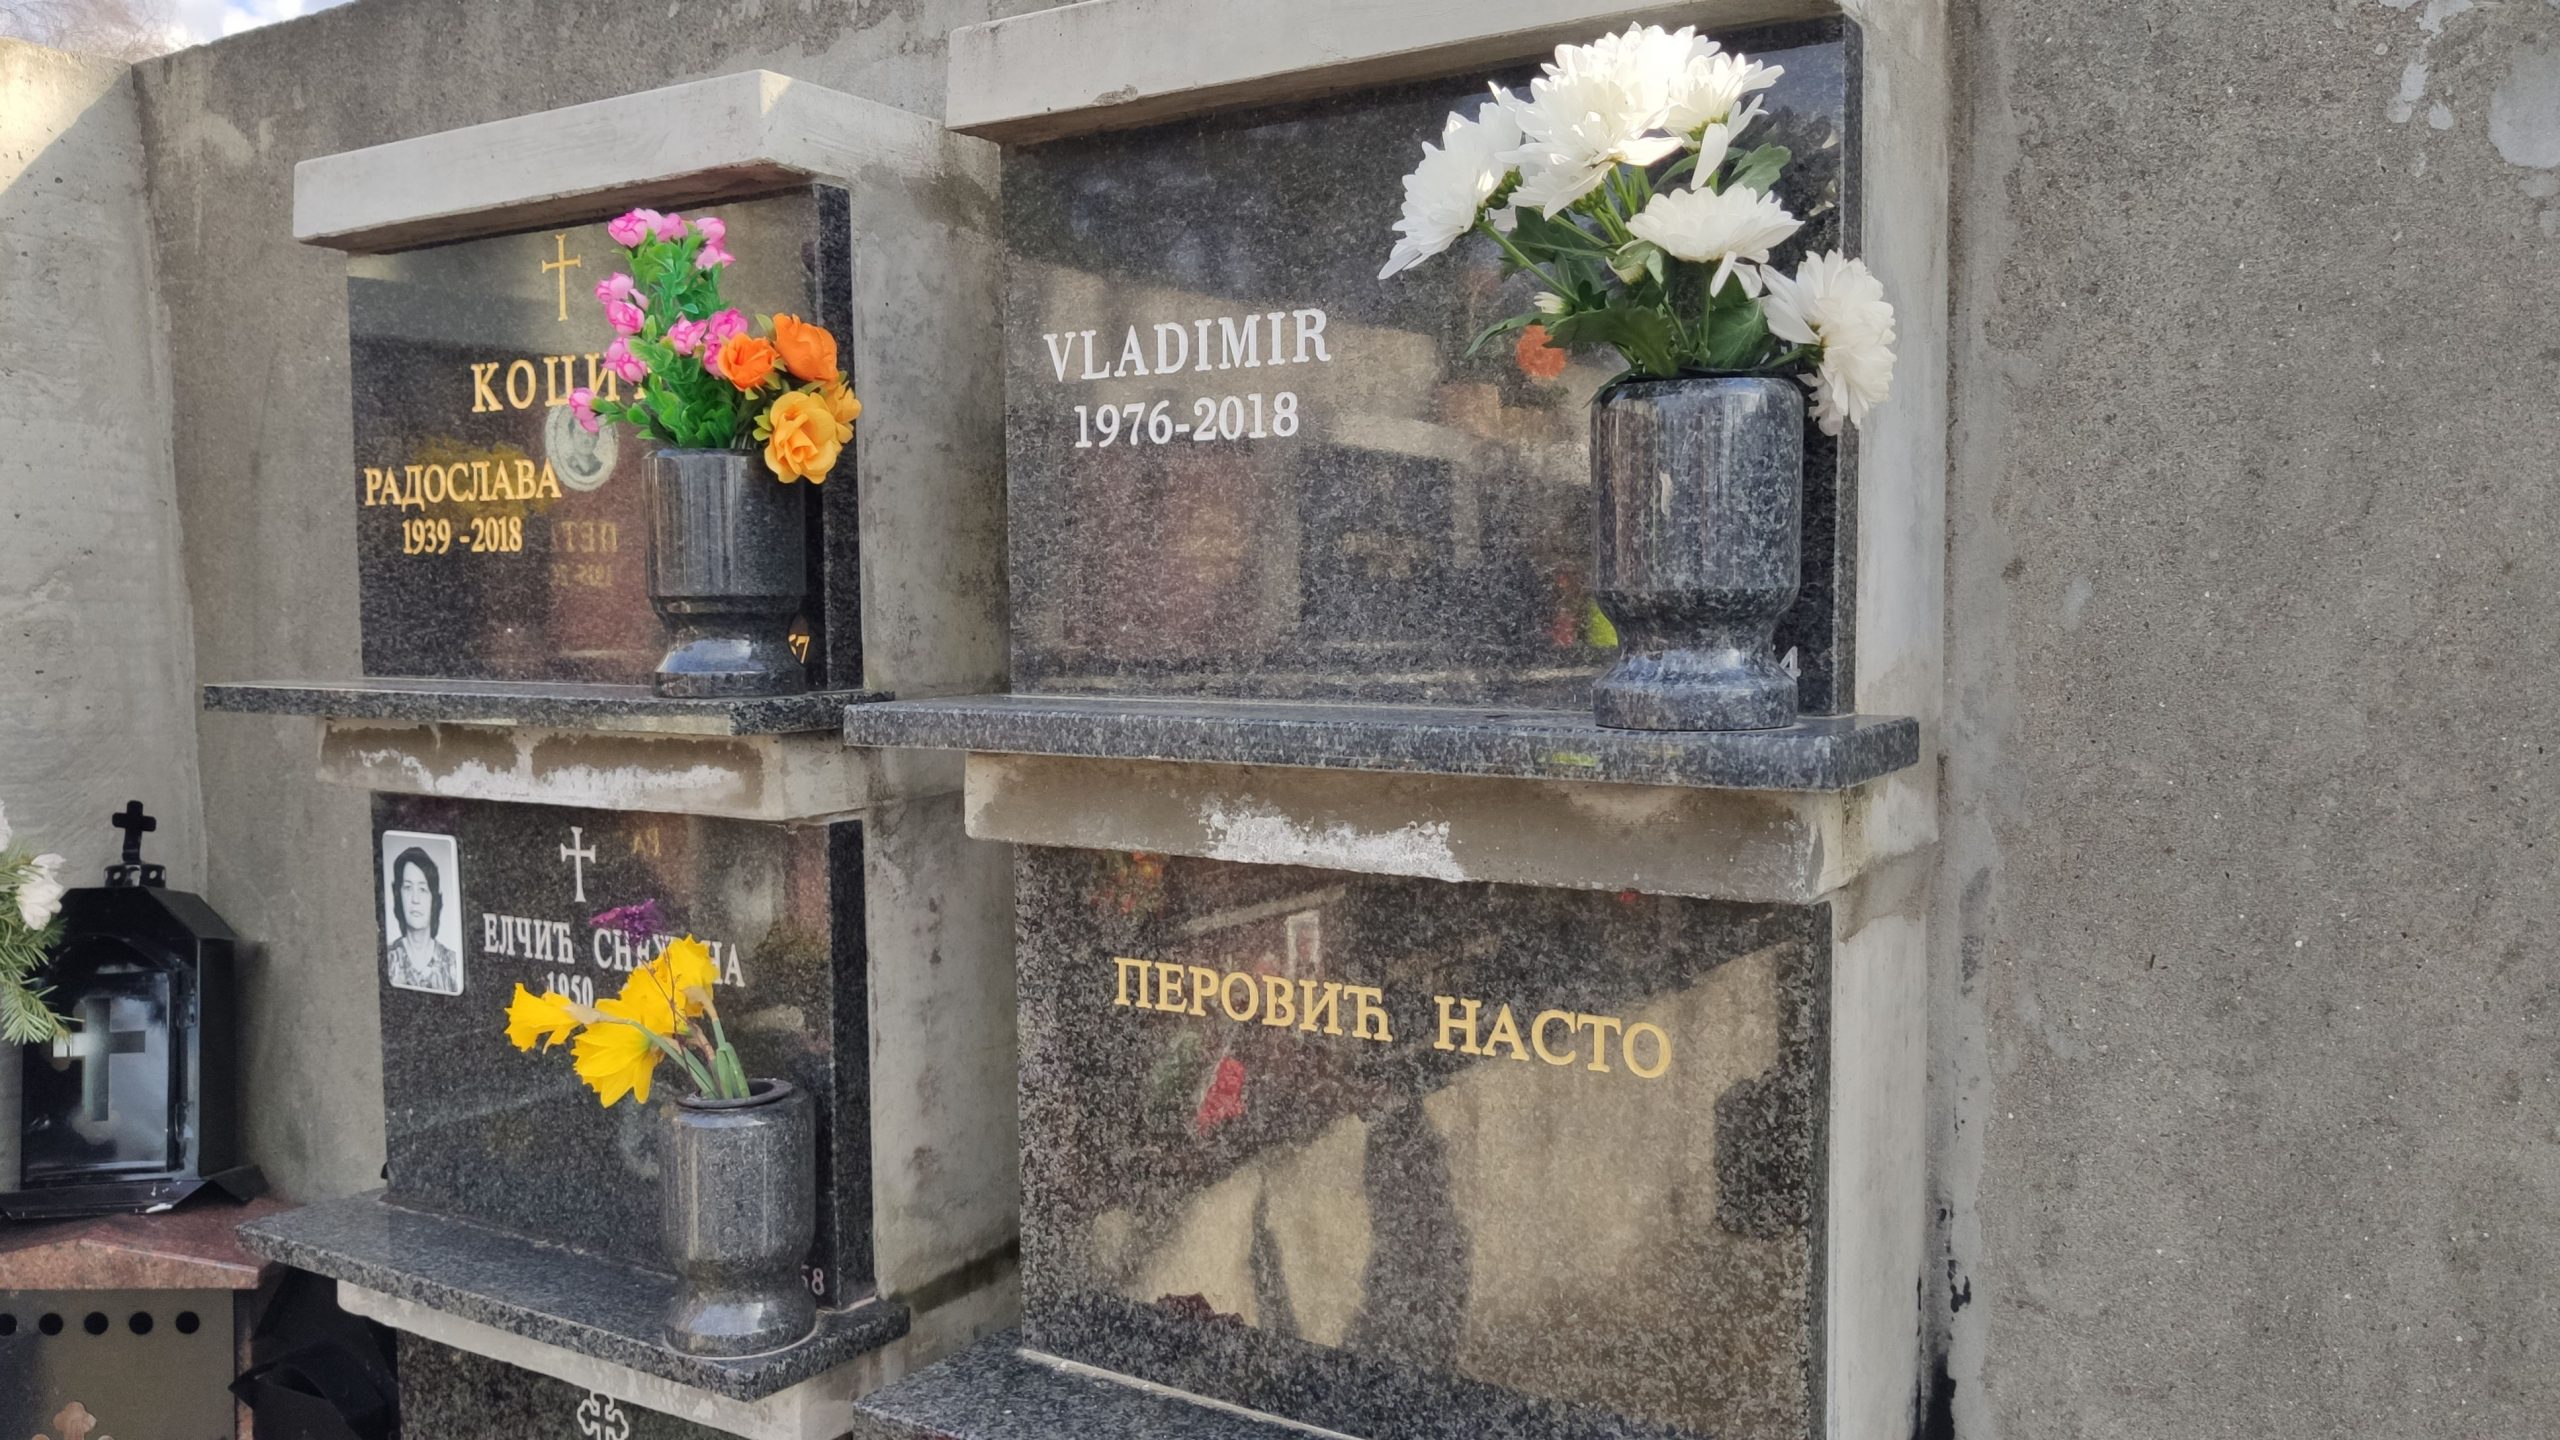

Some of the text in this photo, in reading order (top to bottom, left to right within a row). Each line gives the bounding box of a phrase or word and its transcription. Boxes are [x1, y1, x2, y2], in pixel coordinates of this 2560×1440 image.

[1042, 307, 1332, 382] VLADIMIR
[470, 352, 652, 413] КОЦИ
[1073, 390, 1300, 448] 1976-2018
[363, 458, 563, 513] РАДОСЛАВА
[402, 518, 451, 555] 1939
[482, 912, 575, 964] ЕЛЧИЋ
[1113, 956, 1672, 1079] ПЕРОВИЋ НАСТО
